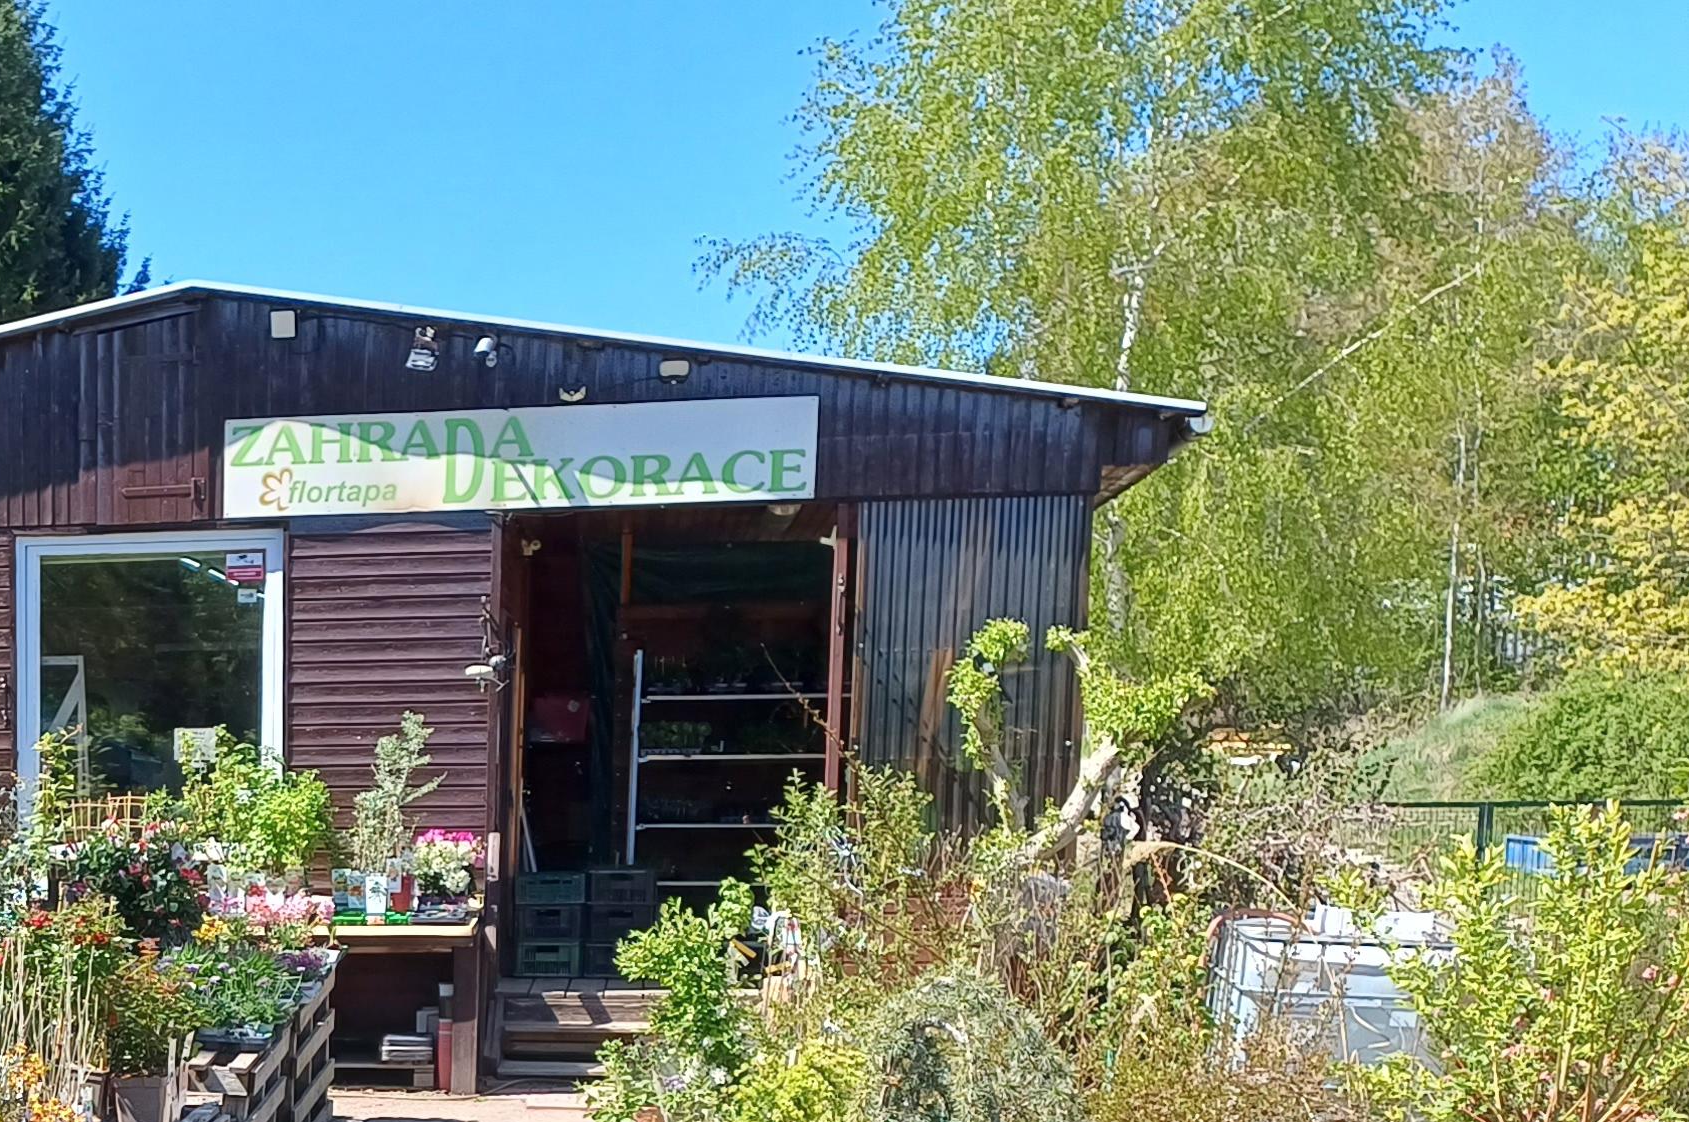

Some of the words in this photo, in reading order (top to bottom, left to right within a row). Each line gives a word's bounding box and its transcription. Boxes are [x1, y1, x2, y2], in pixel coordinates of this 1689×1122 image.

[230, 416, 535, 503] ZAHRADA
[288, 480, 398, 507] flortapa
[442, 418, 807, 504] DEKORACE
